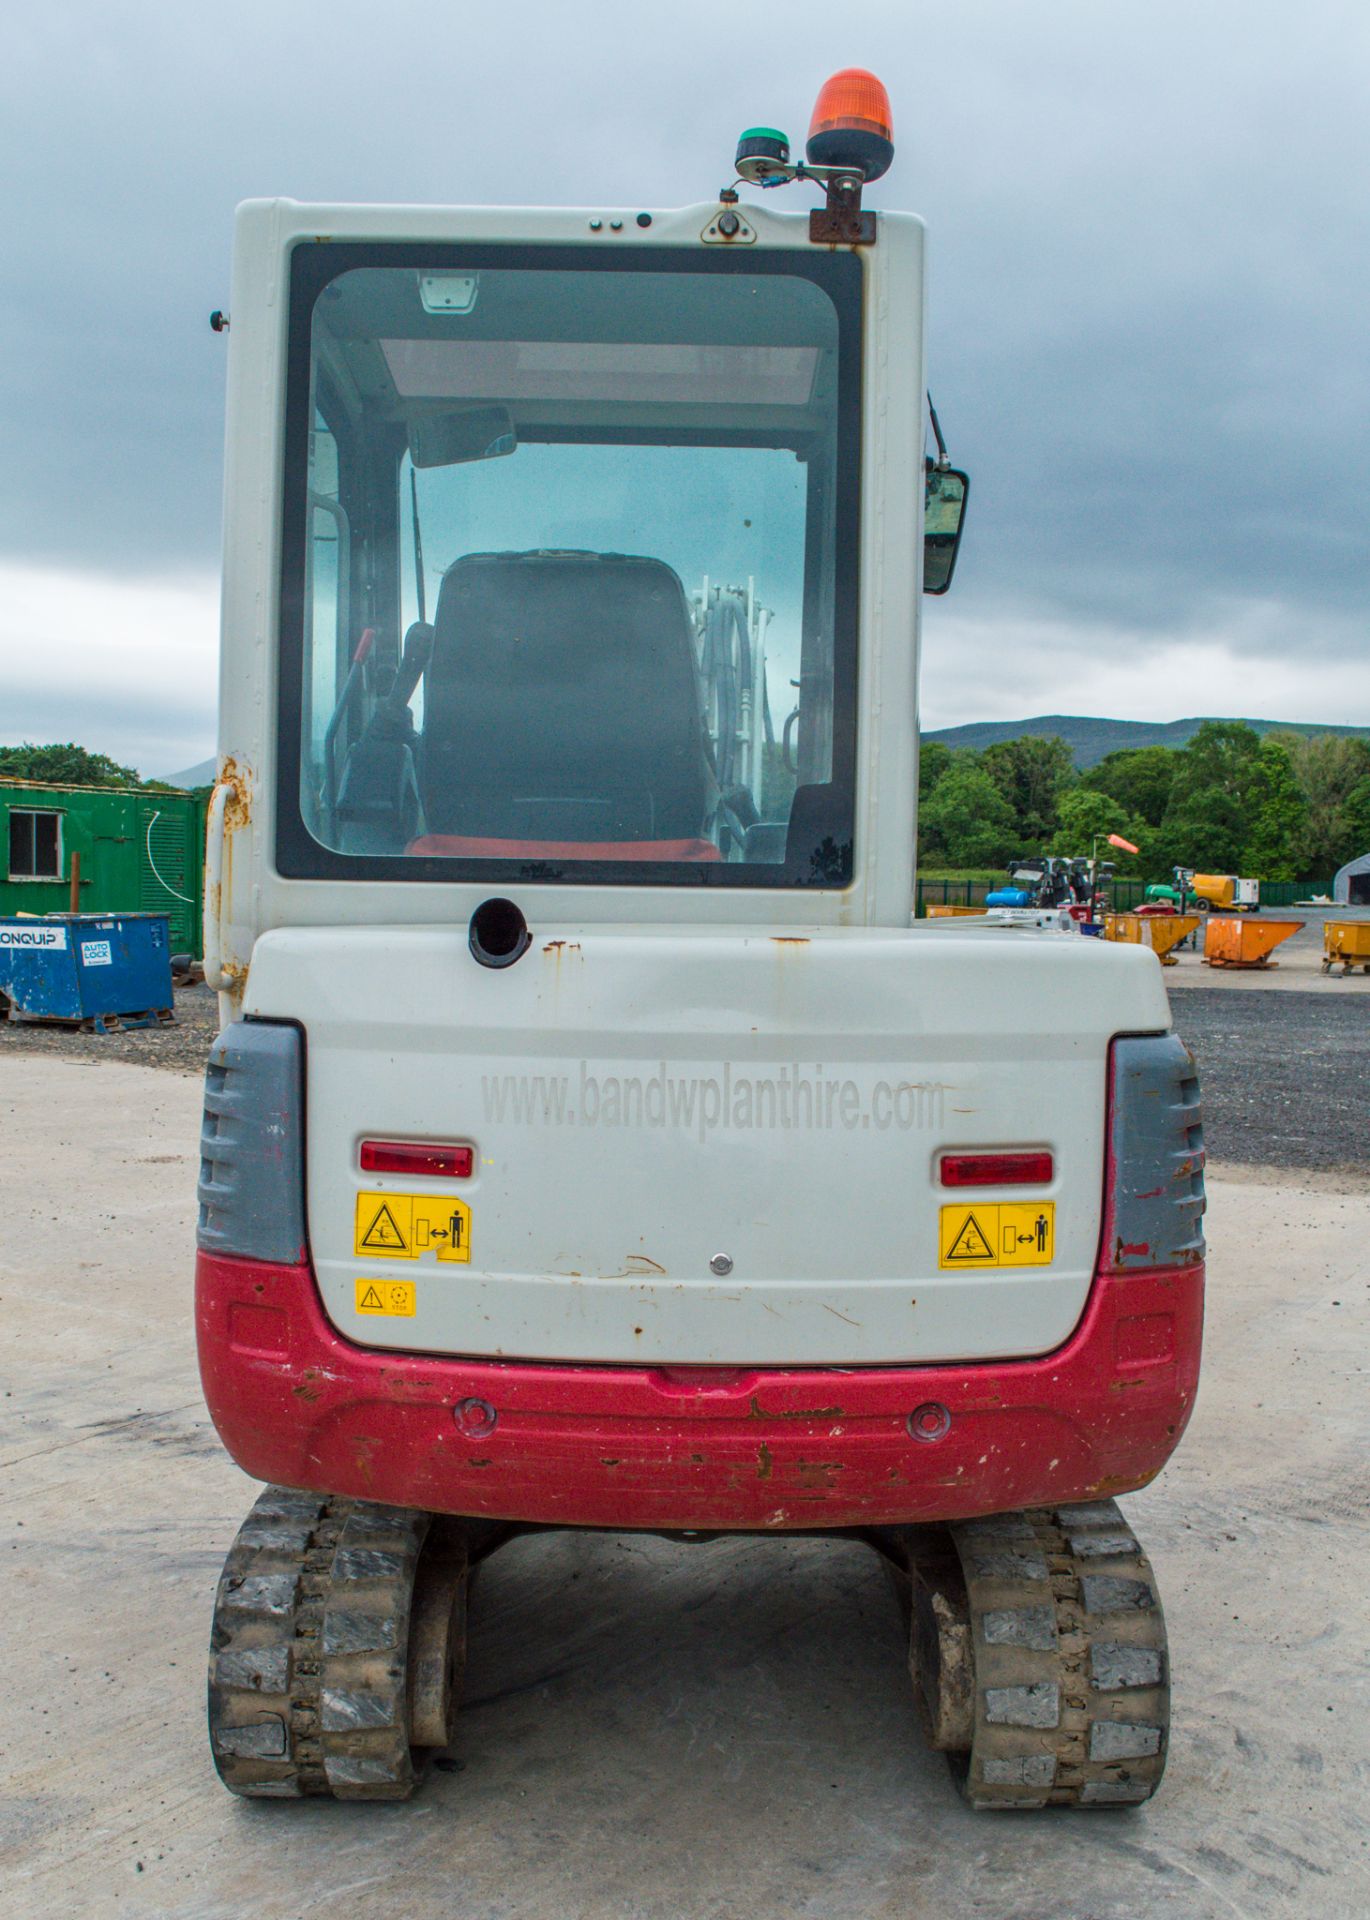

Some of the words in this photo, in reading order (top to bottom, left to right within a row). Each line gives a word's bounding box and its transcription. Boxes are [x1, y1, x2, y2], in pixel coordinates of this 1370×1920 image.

[84, 943, 108, 951] AUTO
[84, 951, 108, 959] LOCK
[482, 1060, 945, 1143] www.bandwplanthire.com
